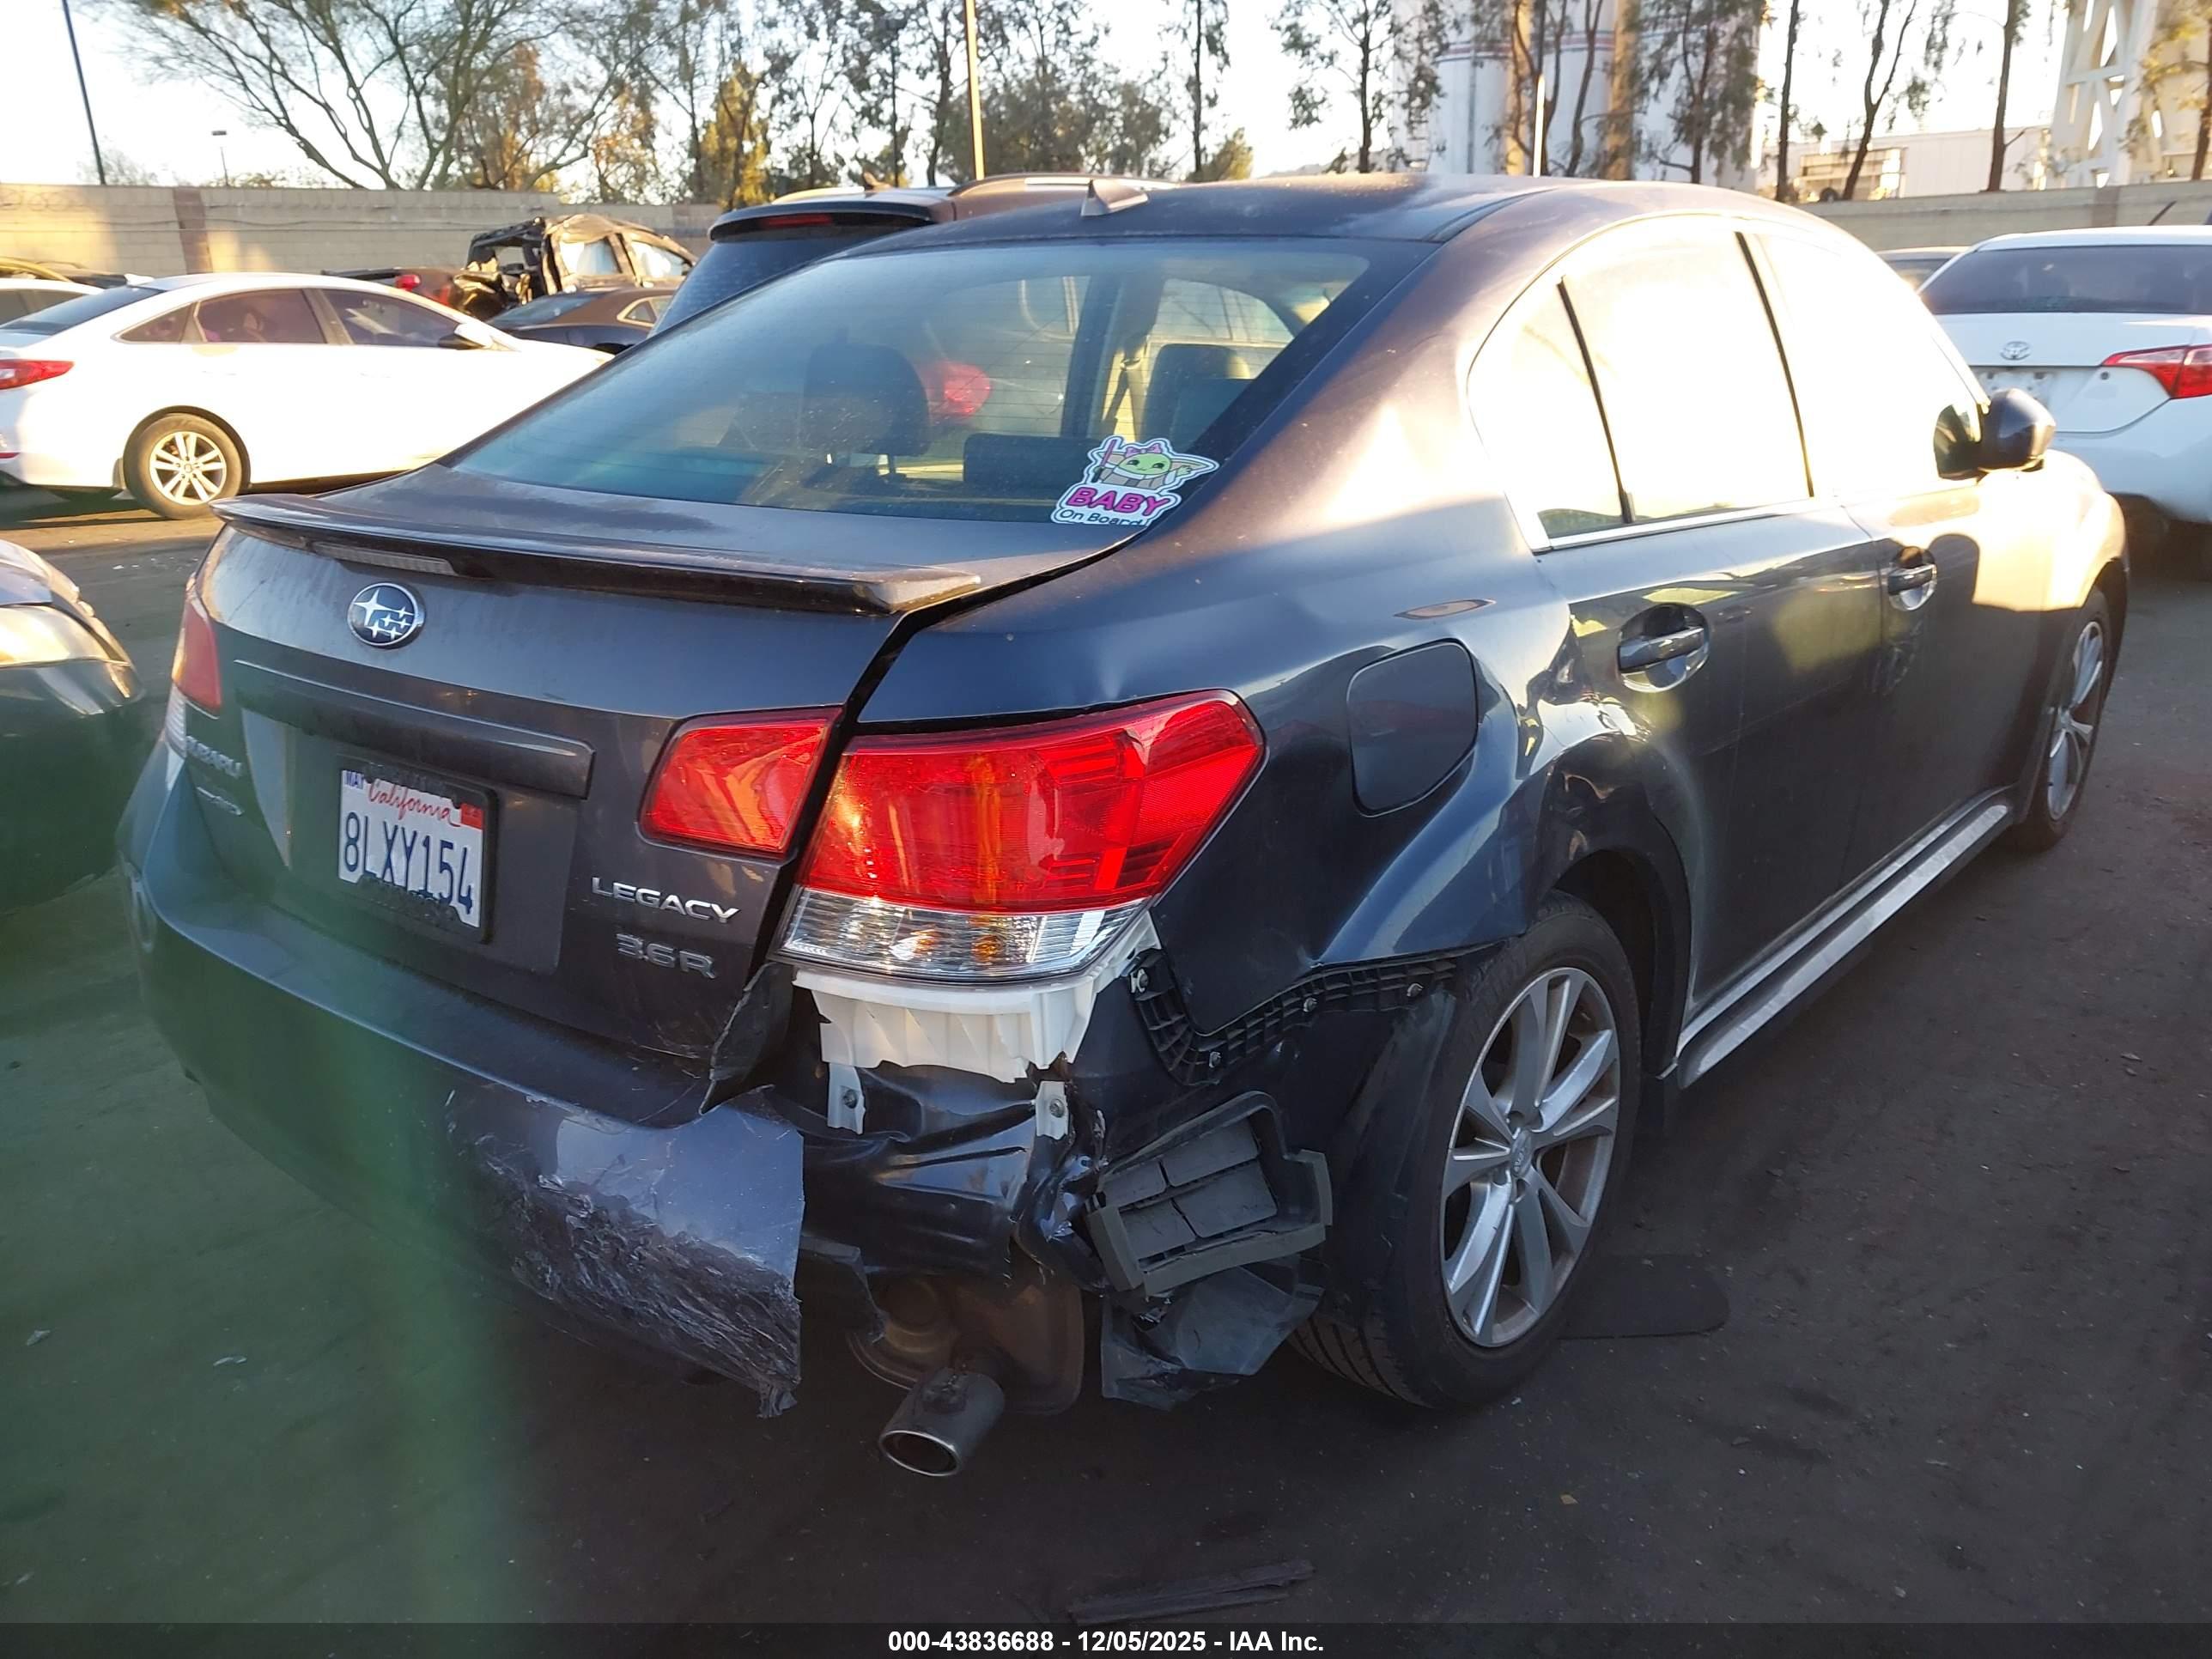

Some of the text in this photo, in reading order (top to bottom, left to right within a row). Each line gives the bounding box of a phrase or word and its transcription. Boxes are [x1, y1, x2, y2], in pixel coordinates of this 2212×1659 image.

[1060, 509, 1084, 520] On
[1066, 486, 1170, 516] BABY
[368, 776, 462, 828] California
[343, 811, 474, 915] 8LXY154
[592, 877, 740, 923] LEGACY
